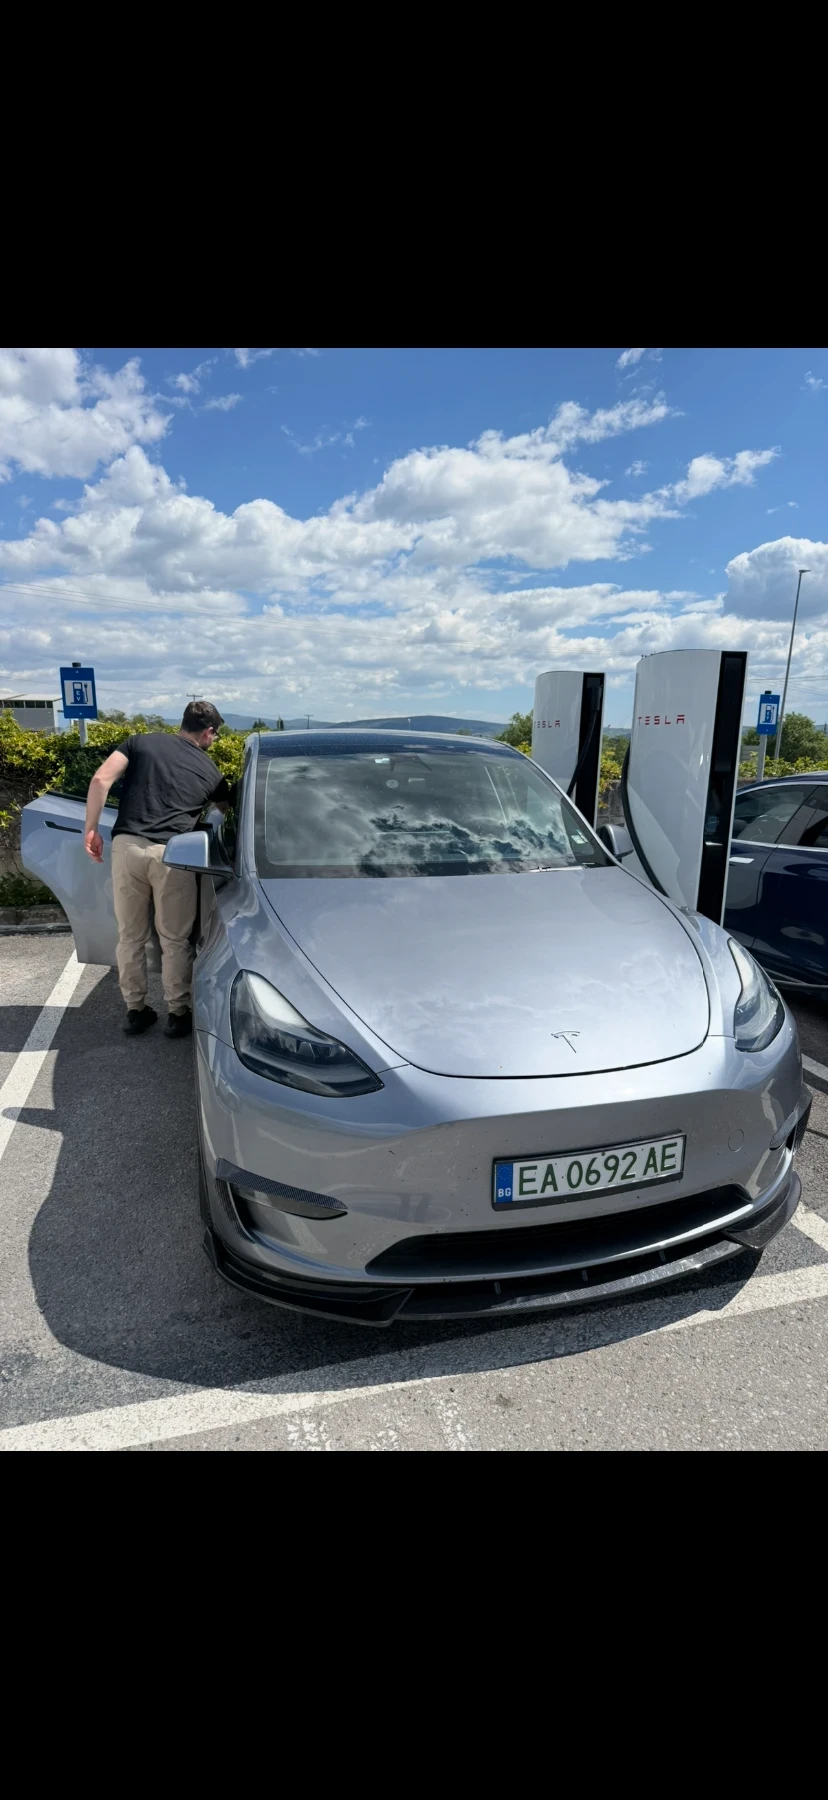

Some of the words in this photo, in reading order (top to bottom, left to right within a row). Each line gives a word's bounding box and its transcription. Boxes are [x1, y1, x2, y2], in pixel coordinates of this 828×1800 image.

[76, 690, 81, 702] EV
[534, 720, 560, 728] TESLA
[638, 715, 685, 726] TESLA
[519, 1164, 558, 1196] EA
[567, 1152, 637, 1189] 0692
[643, 1142, 678, 1175] AE
[498, 1187, 511, 1198] BG
